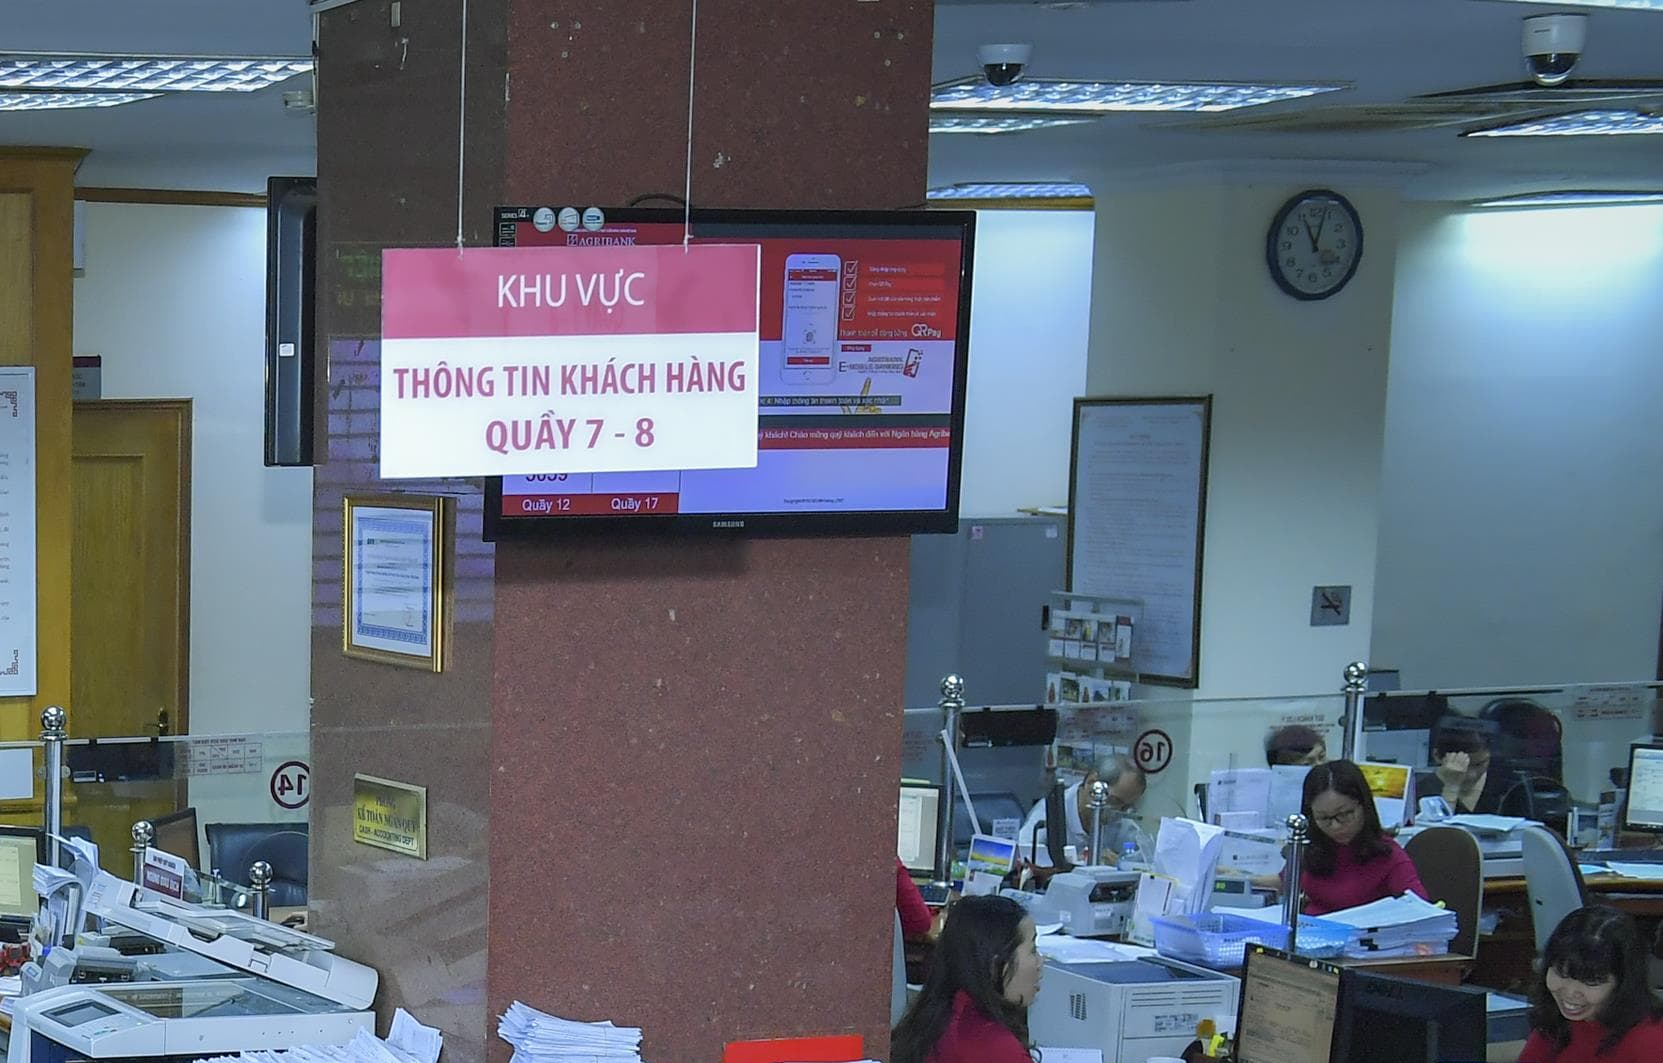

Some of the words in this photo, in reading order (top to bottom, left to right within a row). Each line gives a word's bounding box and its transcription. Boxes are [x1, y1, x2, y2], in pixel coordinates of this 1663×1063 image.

[498, 274, 566, 308] KHU
[576, 268, 645, 313] VỰC
[394, 361, 495, 399] THÔNG
[503, 365, 550, 397] TIN
[561, 357, 656, 396] KHÁCH
[666, 355, 746, 394] HÀNG
[486, 409, 576, 454] QUẦY
[586, 420, 604, 449] 7
[636, 418, 655, 447] 8
[522, 498, 551, 512] Quầy
[555, 498, 570, 510] 12
[611, 496, 641, 511] Quầy
[645, 496, 658, 508] 17
